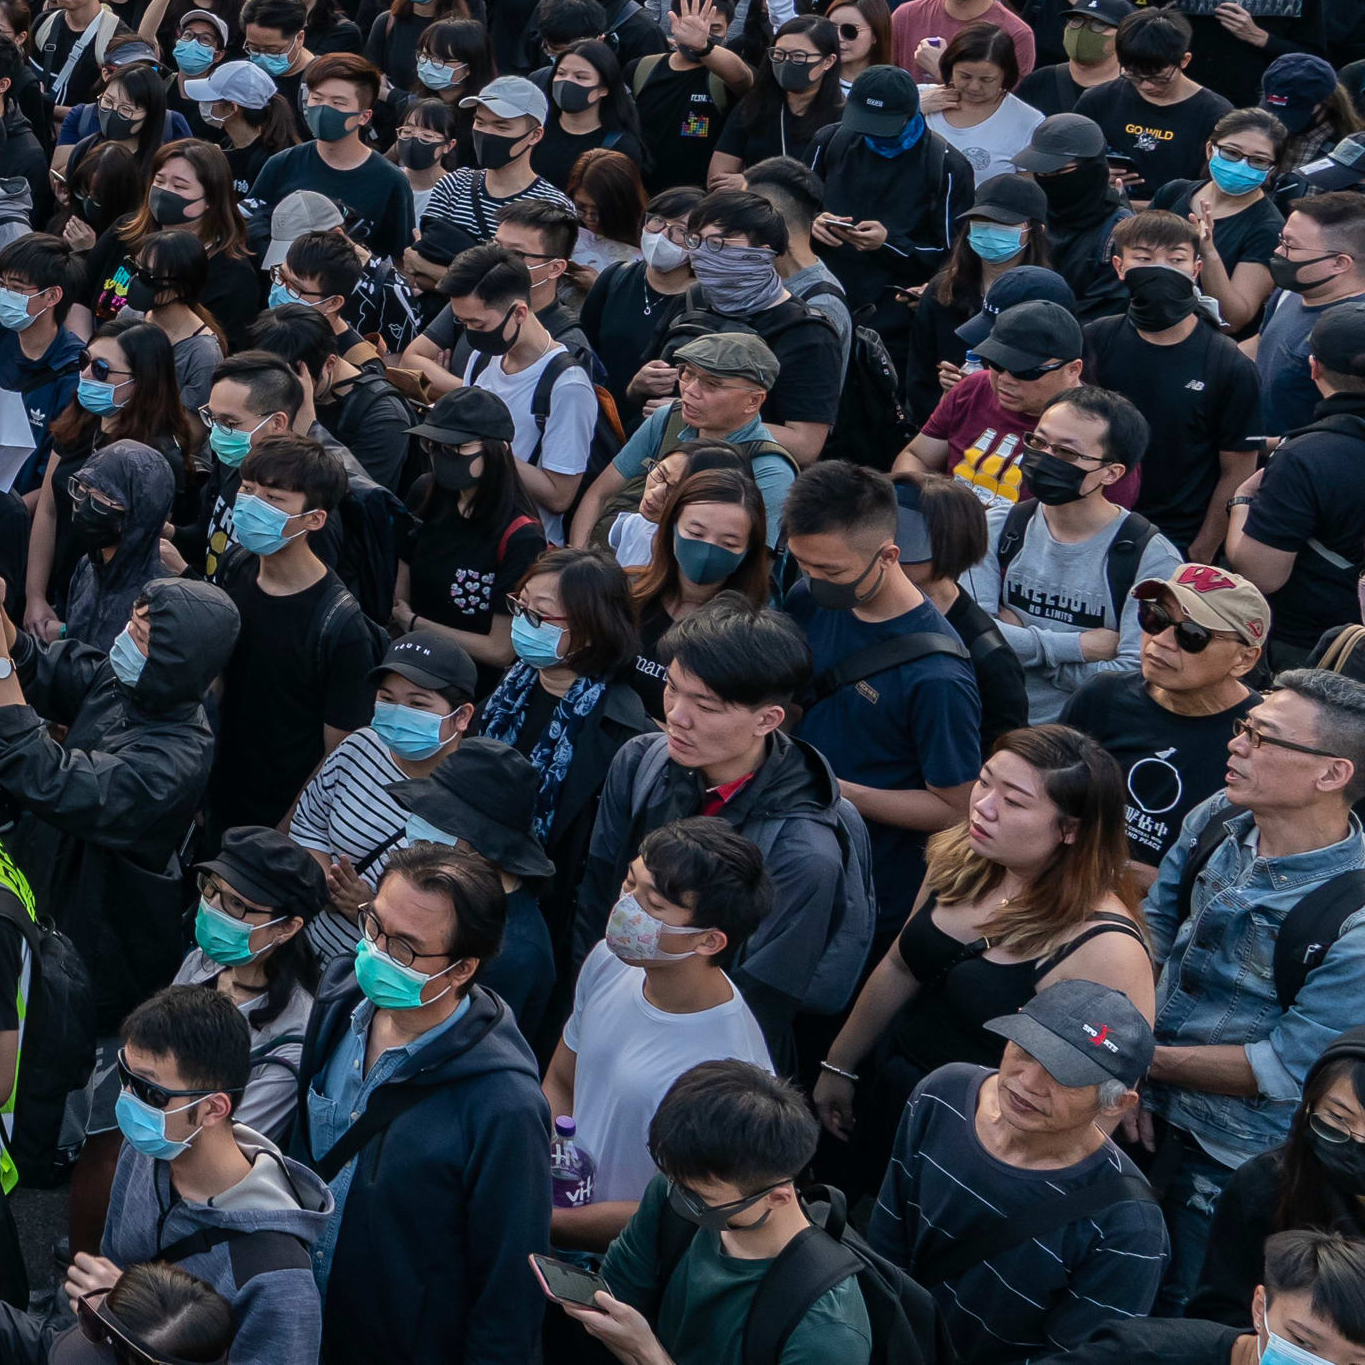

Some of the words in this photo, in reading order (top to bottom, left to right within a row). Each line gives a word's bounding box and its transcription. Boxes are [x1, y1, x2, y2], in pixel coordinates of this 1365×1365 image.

[1125, 124, 1143, 136] GO
[1144, 127, 1174, 141] WILD
[1176, 564, 1237, 593] W
[1007, 579, 1106, 618] FREEDOM
[1029, 604, 1041, 615] NO
[394, 643, 430, 656] YOUTH
[1138, 837, 1162, 851] PEACE
